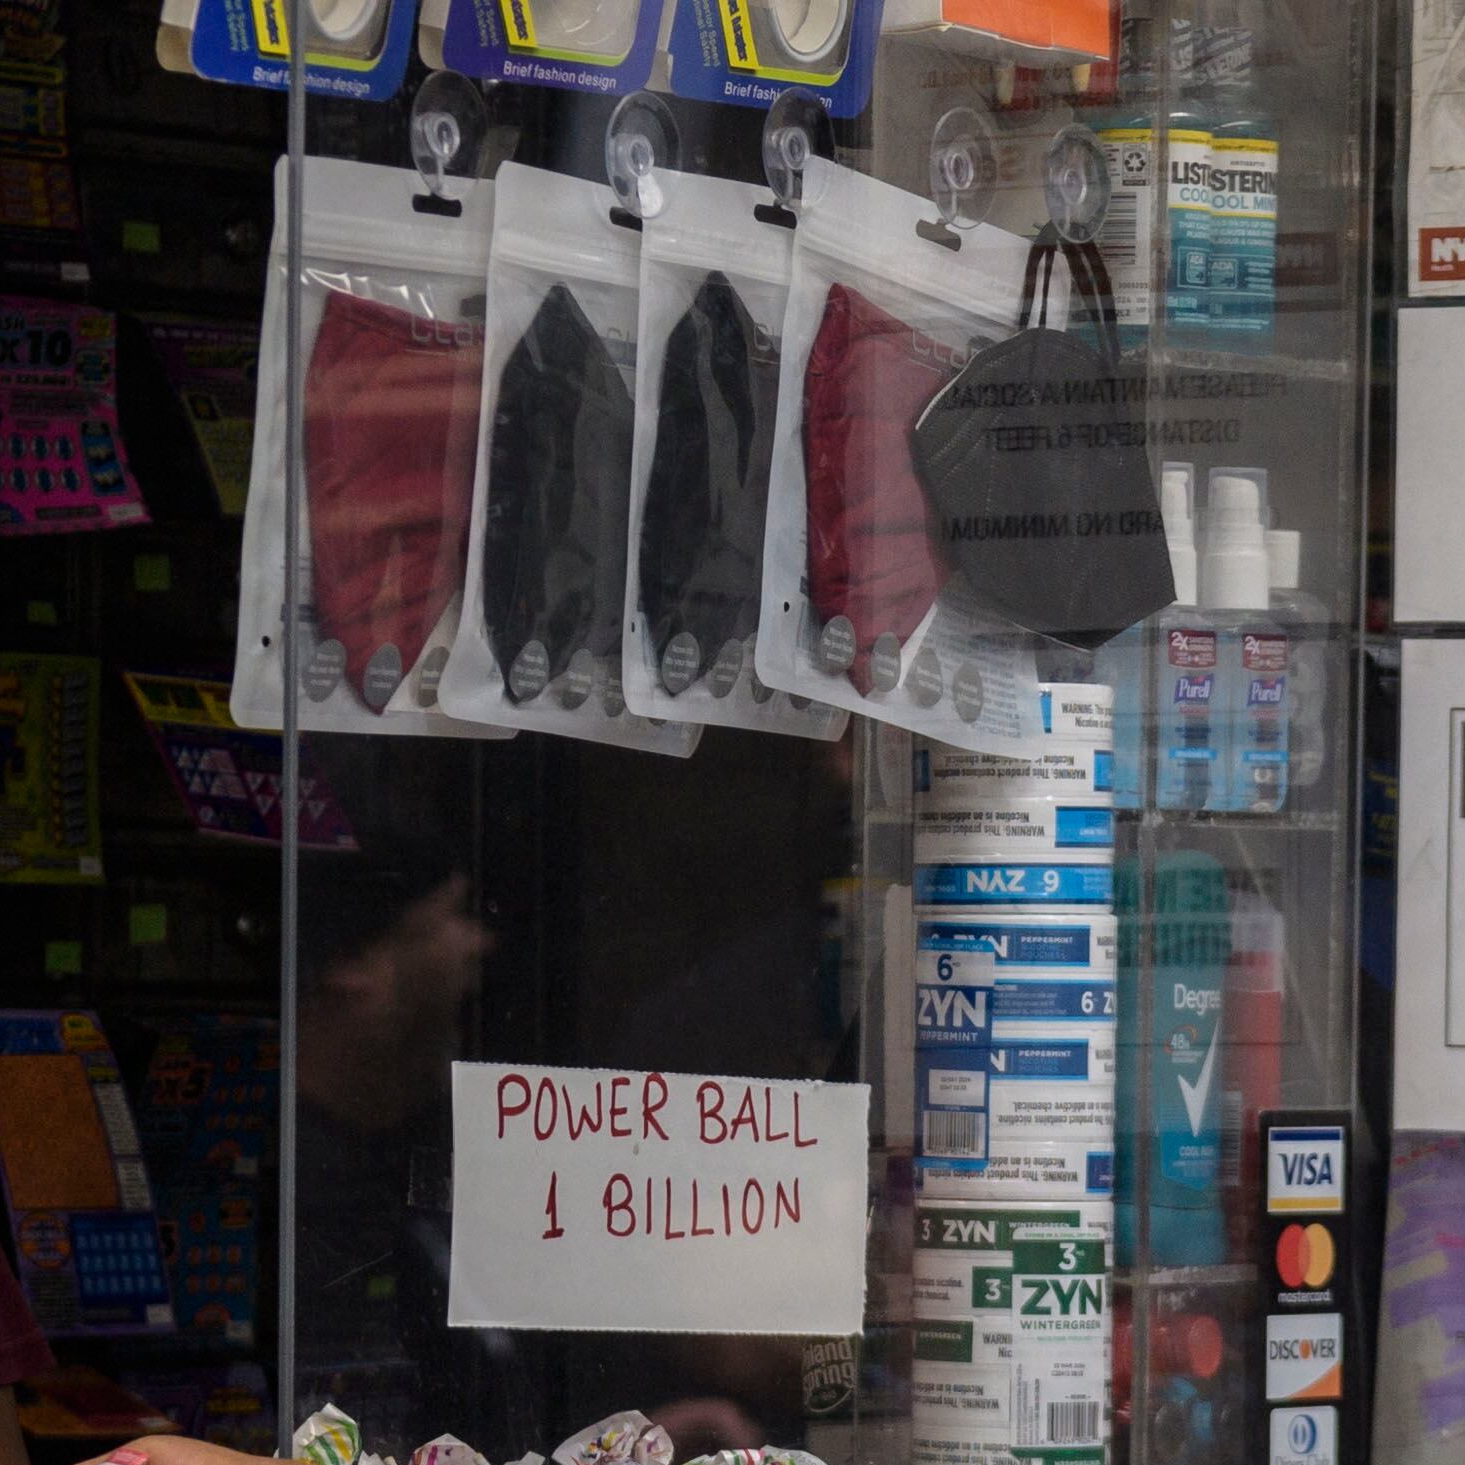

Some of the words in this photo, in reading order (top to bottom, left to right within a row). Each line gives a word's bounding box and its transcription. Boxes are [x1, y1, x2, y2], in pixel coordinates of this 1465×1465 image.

[252, 64, 289, 86] Brief
[502, 60, 533, 80] Brief
[534, 64, 577, 87] fashion
[578, 69, 618, 93] design
[723, 80, 753, 99] Brief
[1178, 677, 1212, 699] Purell
[1251, 681, 1283, 702] Purell
[967, 870, 1025, 893] ZYN
[936, 953, 954, 981] 6
[918, 988, 987, 1028] ZYN
[496, 1073, 670, 1142] POWER
[696, 1080, 819, 1149] BALL
[1278, 1152, 1333, 1187] VISA
[542, 1171, 565, 1240] 1
[603, 1173, 802, 1239] BILLION
[942, 1219, 996, 1244] ZYN
[1058, 1242, 1077, 1271] 3
[985, 1278, 1001, 1301] 3
[1020, 1278, 1103, 1316] ZYN
[1277, 1288, 1332, 1304] mastercard
[1020, 1319, 1102, 1331] WINTERGREEN
[1269, 1337, 1337, 1361] DISCOVER
